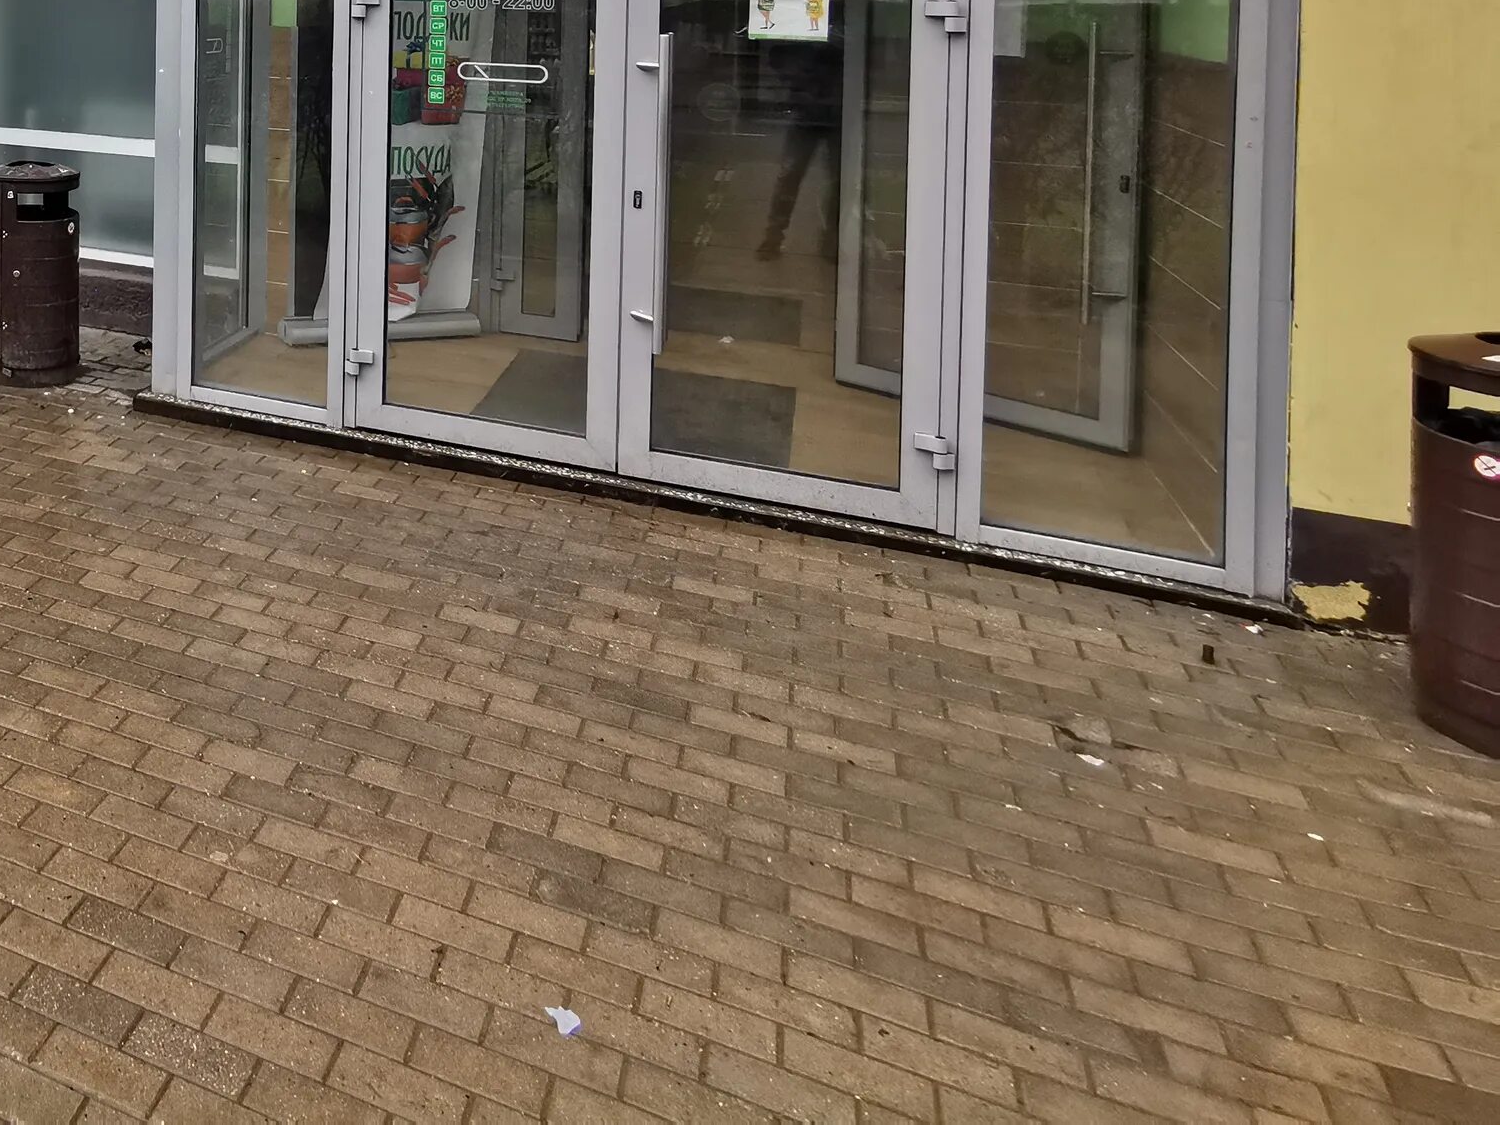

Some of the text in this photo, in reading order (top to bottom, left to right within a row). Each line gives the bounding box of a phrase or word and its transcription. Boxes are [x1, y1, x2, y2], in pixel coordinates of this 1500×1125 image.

[432, 4, 445, 13] ВТ
[431, 22, 444, 31] СР
[431, 39, 444, 48] ЧТ
[430, 56, 443, 65] ПТ
[430, 74, 443, 82] СБ
[429, 91, 443, 100] ВС
[391, 145, 451, 175] ПОСУДА
